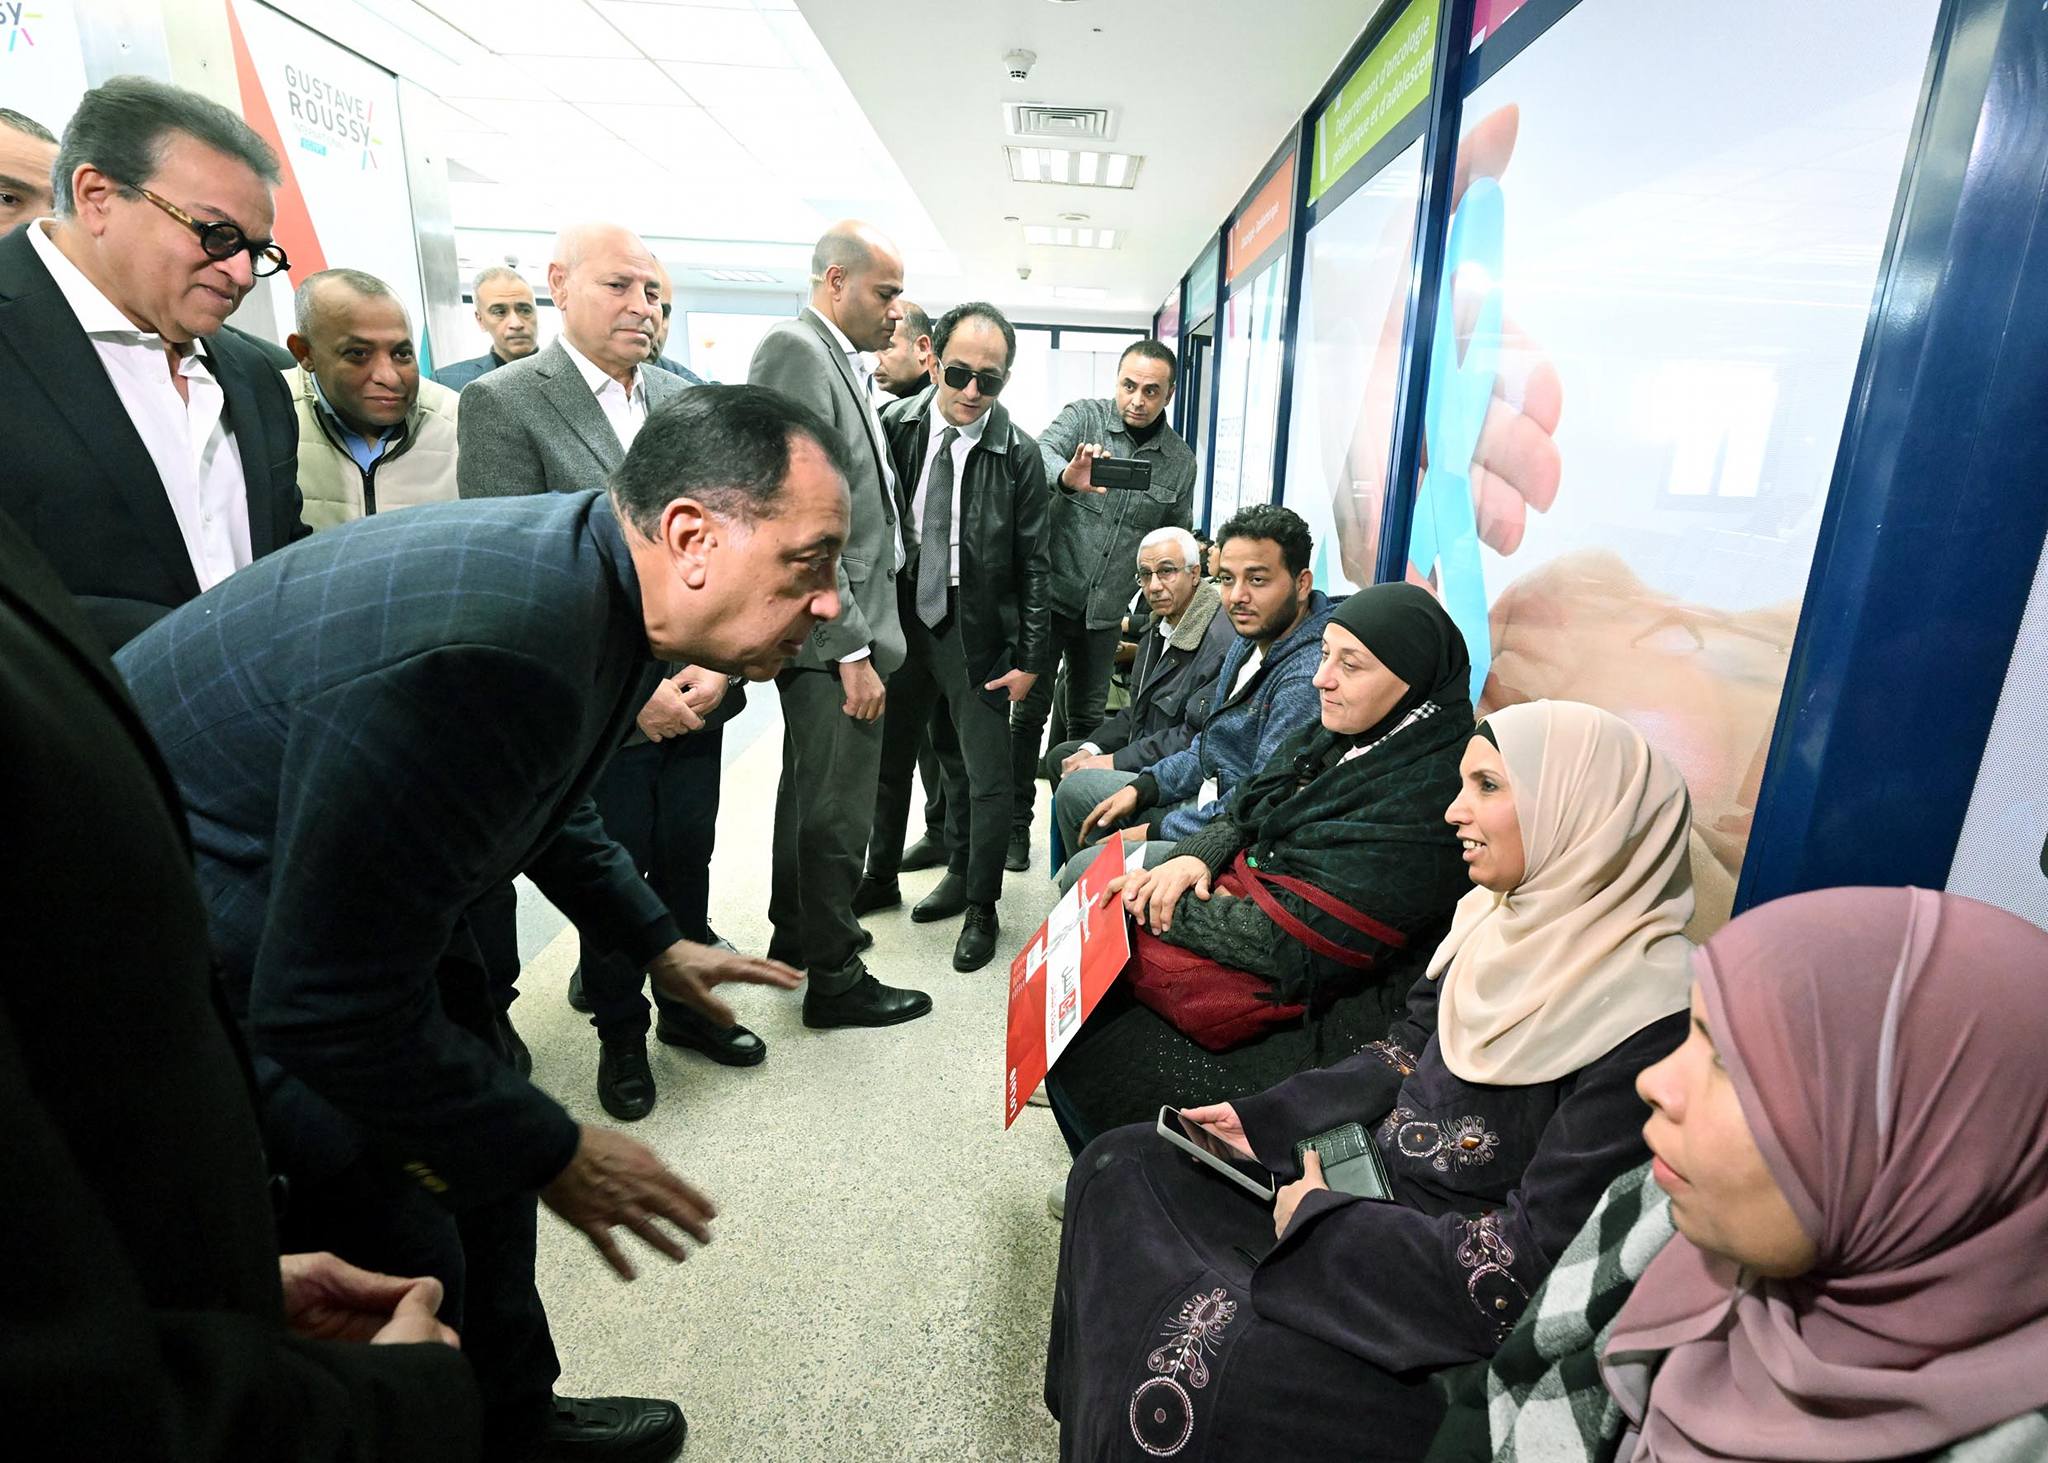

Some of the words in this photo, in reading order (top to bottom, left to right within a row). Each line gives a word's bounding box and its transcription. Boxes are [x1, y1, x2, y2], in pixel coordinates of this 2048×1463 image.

[1380, 15, 1431, 87] d'oncologie
[285, 64, 365, 120] GUSTAVE
[288, 90, 370, 147] ROUSSY
